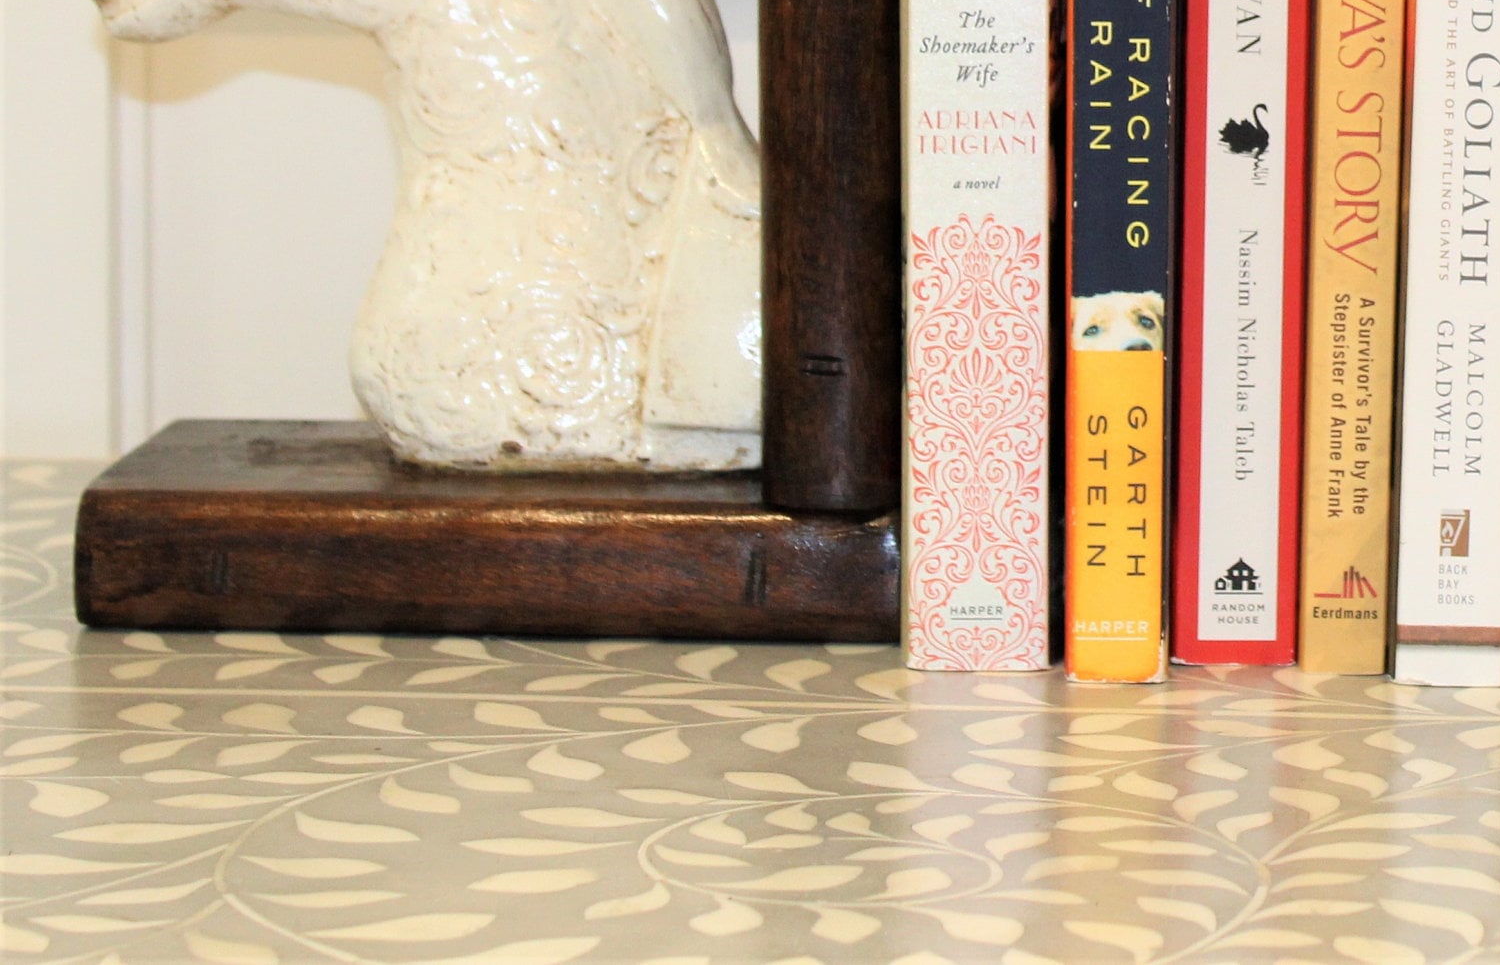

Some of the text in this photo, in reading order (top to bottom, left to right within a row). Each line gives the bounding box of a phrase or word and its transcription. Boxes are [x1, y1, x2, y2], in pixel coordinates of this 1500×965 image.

[959, 11, 995, 30] The
[919, 35, 1036, 54] Shoemaker's
[1446, 19, 1458, 52] THE
[956, 64, 999, 87] Wife
[1089, 20, 1113, 150] RAIN
[1445, 59, 1456, 91] ART
[918, 110, 1037, 130] ADRIANA
[1444, 99, 1455, 120] OF
[1126, 37, 1151, 248] RACING
[953, 176, 1000, 190] a novel
[1323, 89, 1386, 276] STORY
[1440, 127, 1455, 212] BATTLING
[1438, 218, 1451, 282] GIANTS
[1234, 229, 1259, 482] Nassim Nicholas Taleb
[1327, 293, 1350, 519] Stepsister of Anne Frank
[1350, 297, 1375, 515] A Survivor's Tale by the
[1432, 319, 1454, 478] GLADWELL
[1463, 323, 1487, 476] MALCOLM
[1086, 415, 1108, 568] STEIN
[1126, 404, 1148, 578] GARTH
[1438, 564, 1468, 575] BACK
[1437, 579, 1460, 590] BAY
[950, 605, 1004, 616] HARPER
[1211, 603, 1266, 613] RANDOM
[1313, 605, 1379, 621] Eerdmans
[1437, 594, 1475, 605] BOOKS
[1073, 621, 1149, 634] HARPER
[1217, 615, 1260, 625] HOUSE
